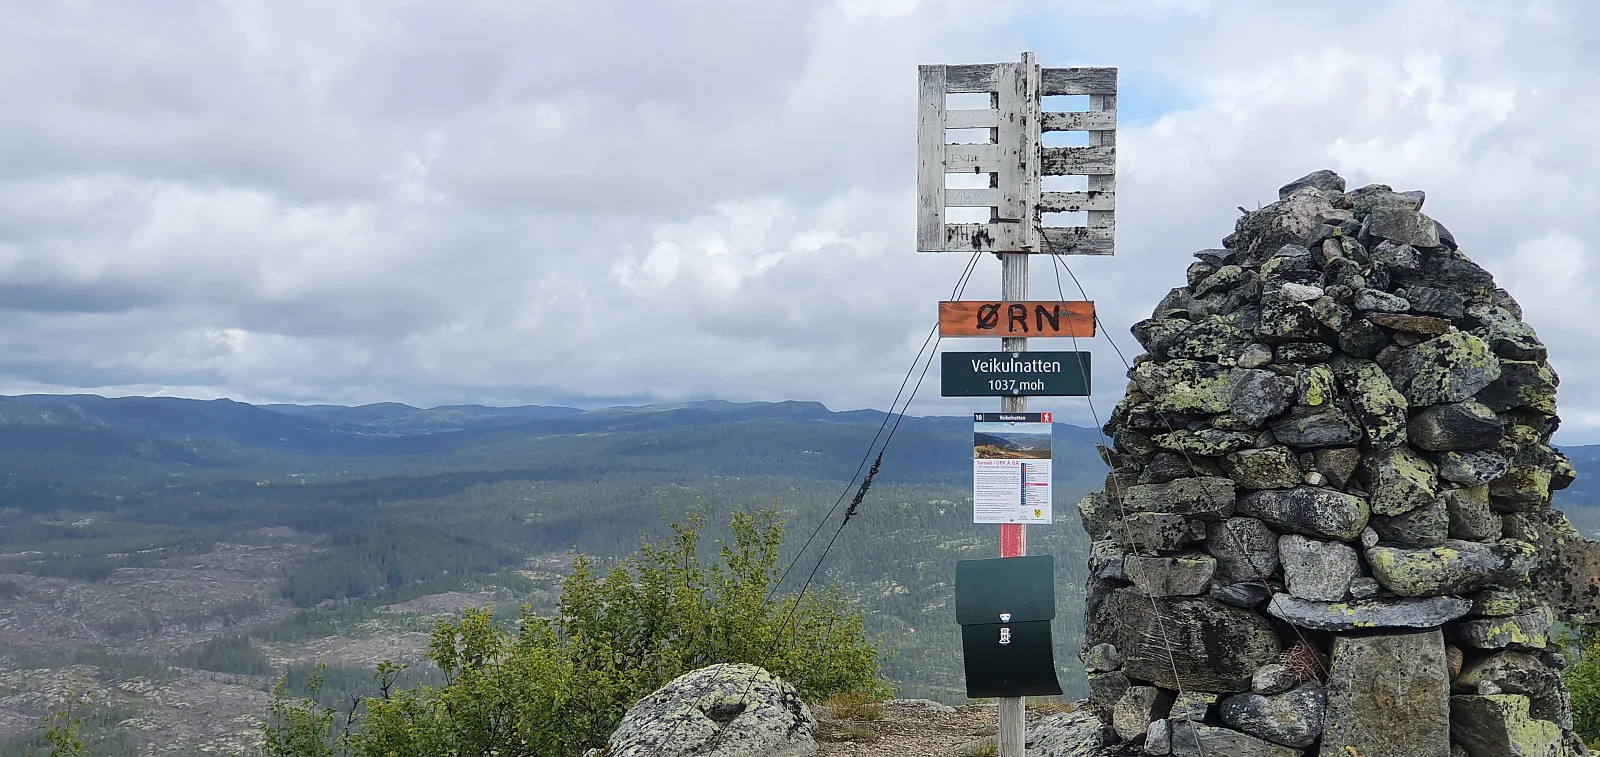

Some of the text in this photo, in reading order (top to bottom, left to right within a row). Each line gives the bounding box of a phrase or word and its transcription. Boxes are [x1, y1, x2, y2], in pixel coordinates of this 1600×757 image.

[976, 303, 1060, 333] ØRN
[971, 357, 1061, 373] Veikulnatten
[988, 378, 1045, 391] 1037 moh
